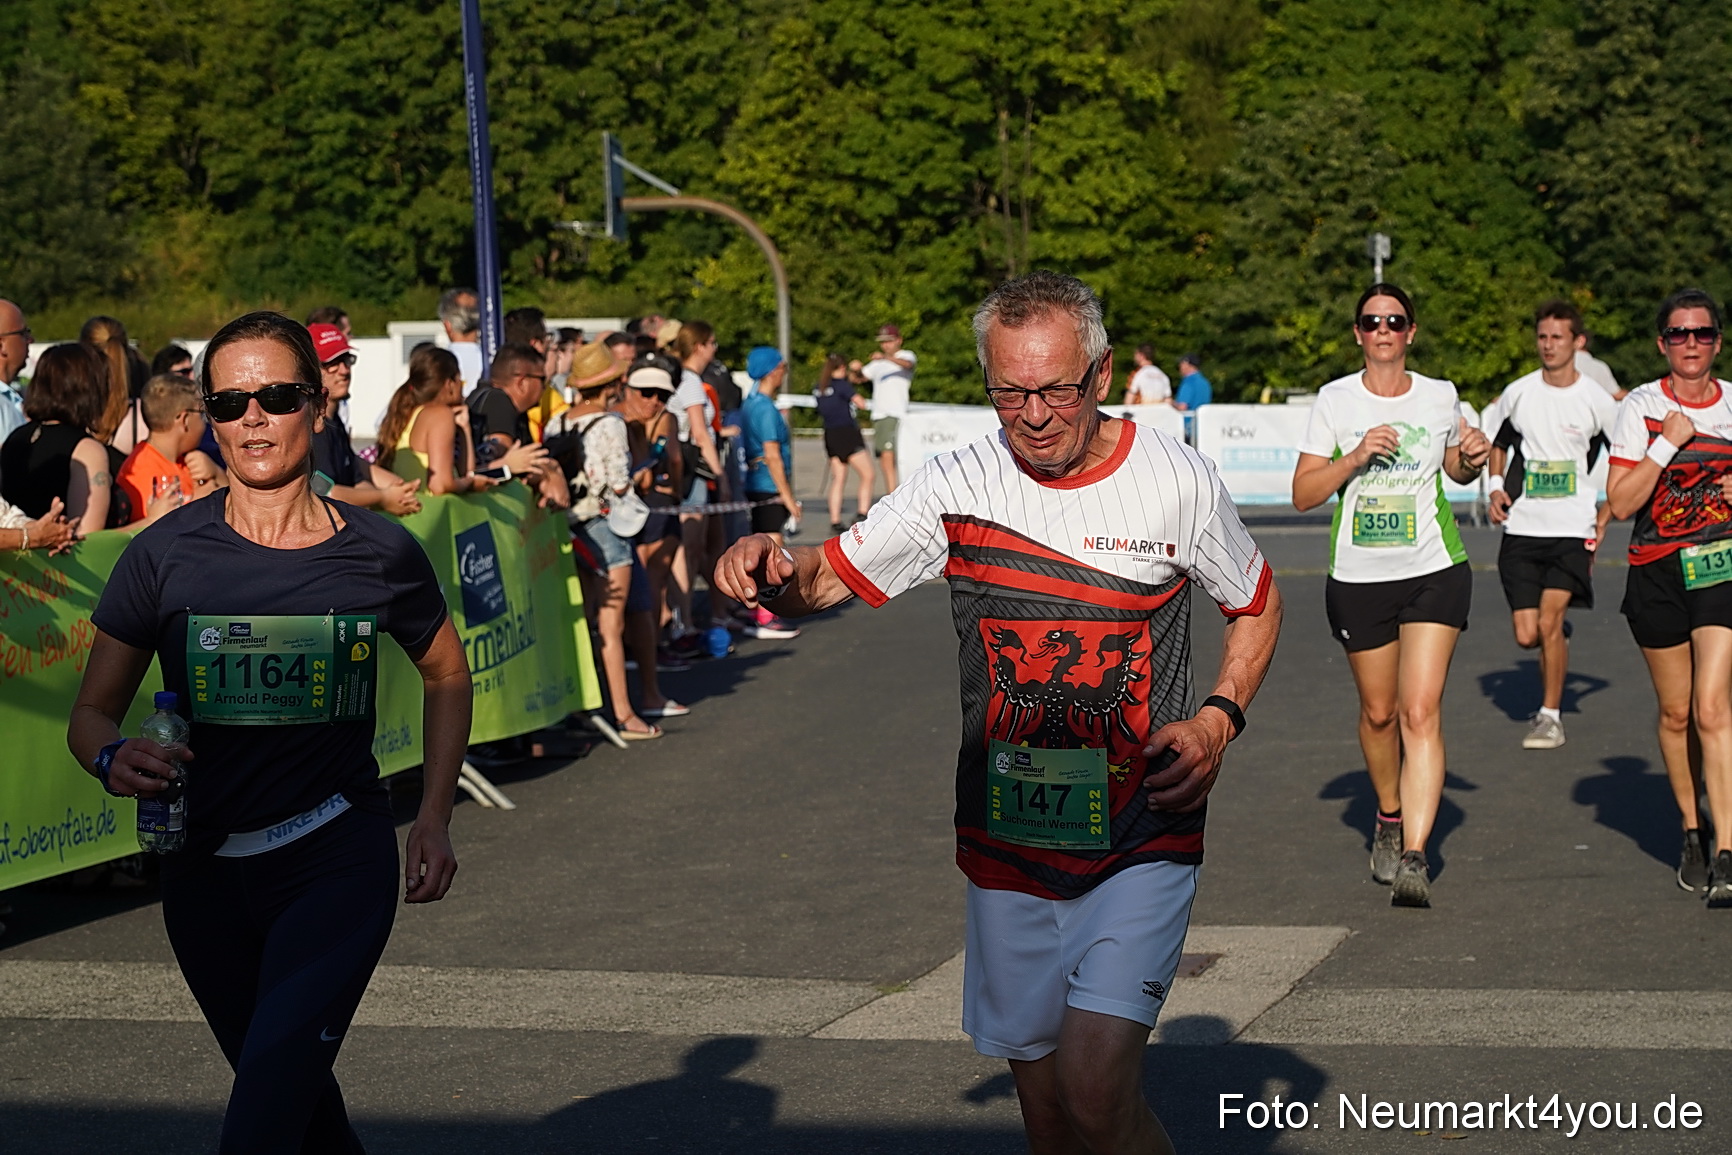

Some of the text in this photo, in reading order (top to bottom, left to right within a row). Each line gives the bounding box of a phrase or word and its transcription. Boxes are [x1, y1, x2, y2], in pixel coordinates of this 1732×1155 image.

[921, 431, 959, 444] NOW
[1221, 426, 1257, 440] NOW
[1535, 473, 1568, 486] 1967
[1364, 513, 1399, 530] 350
[1084, 537, 1164, 556] NEUMARKT
[222, 635, 268, 645] Firmenlauf
[338, 628, 346, 643] AOK
[211, 653, 309, 689] 1164
[195, 666, 207, 702] RUN
[312, 659, 326, 708] 2022
[214, 693, 304, 708] Arnold Peggy
[1011, 764, 1045, 774] Firmenlauf
[993, 786, 1001, 820] RUN
[1011, 780, 1072, 816] 147
[1000, 812, 1090, 829] Suchomel Werner
[1089, 789, 1103, 835] 2022
[266, 812, 314, 842] NIKE
